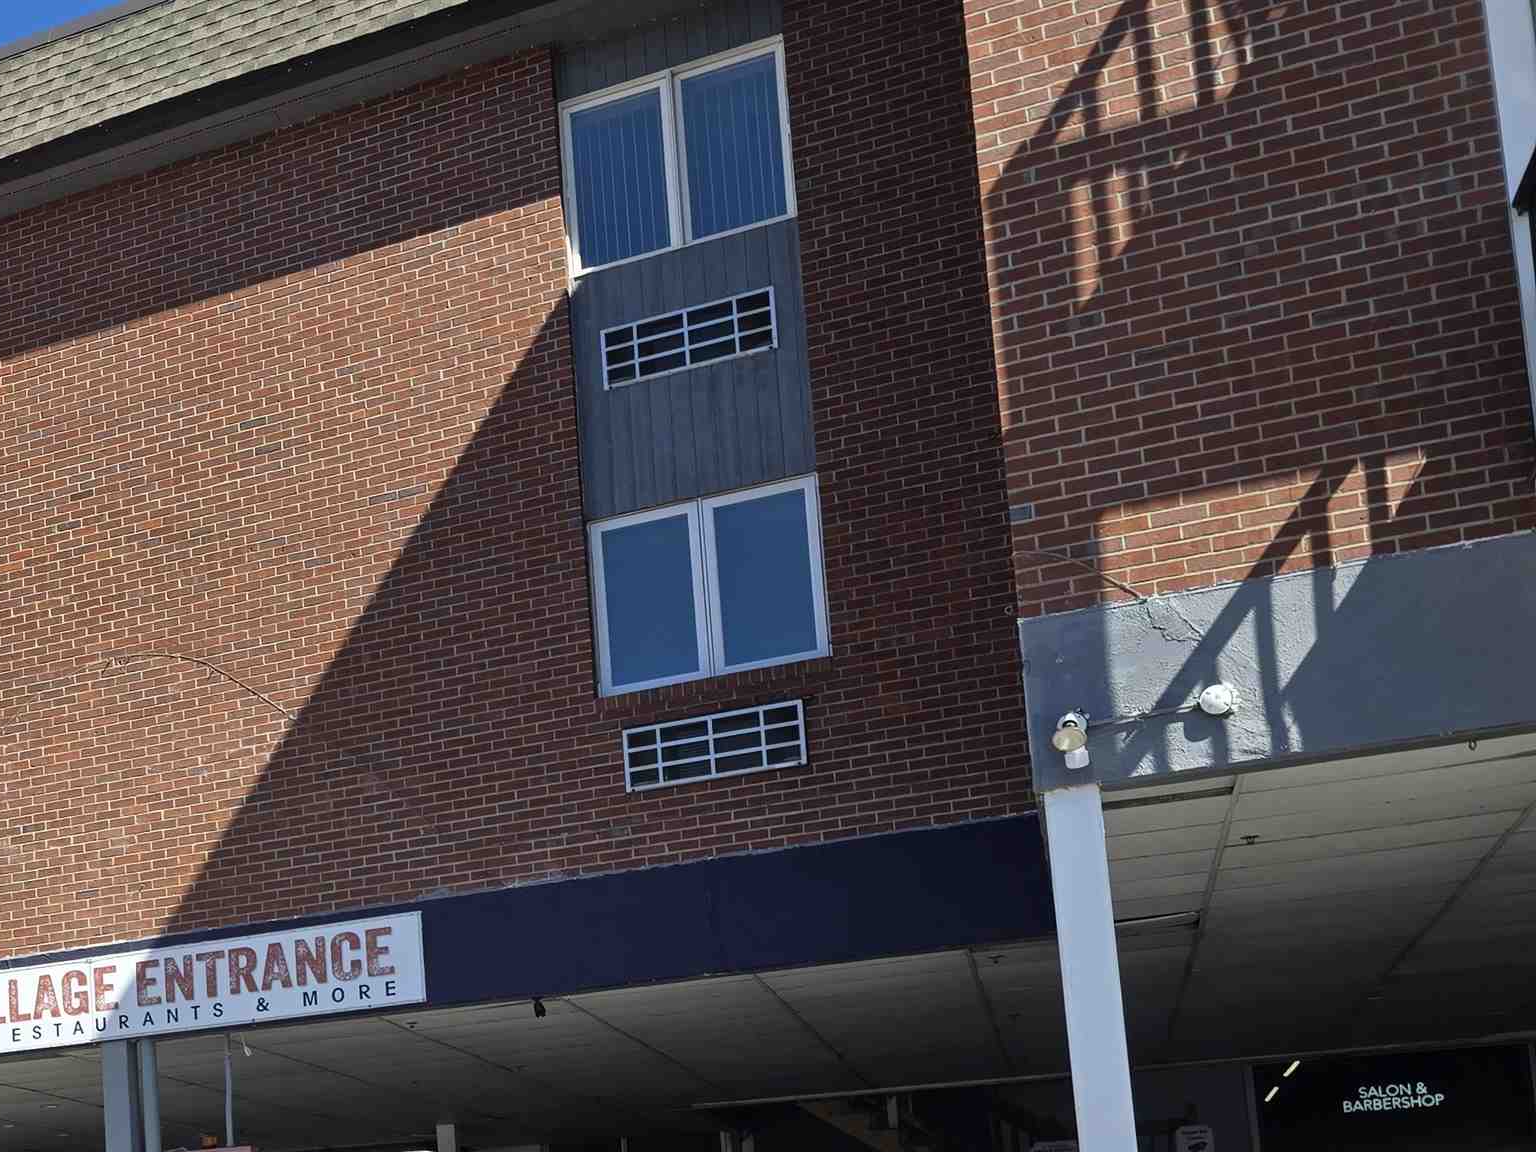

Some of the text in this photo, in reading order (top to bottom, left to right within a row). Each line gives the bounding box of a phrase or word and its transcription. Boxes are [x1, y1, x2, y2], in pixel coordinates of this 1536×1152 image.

[136, 926, 396, 1007] ENTRANCE
[255, 997, 271, 1012] &
[302, 980, 396, 1006] MORE
[1343, 1093, 1444, 1113] BARBERSHOP
[1358, 1081, 1428, 1099] SALON &
